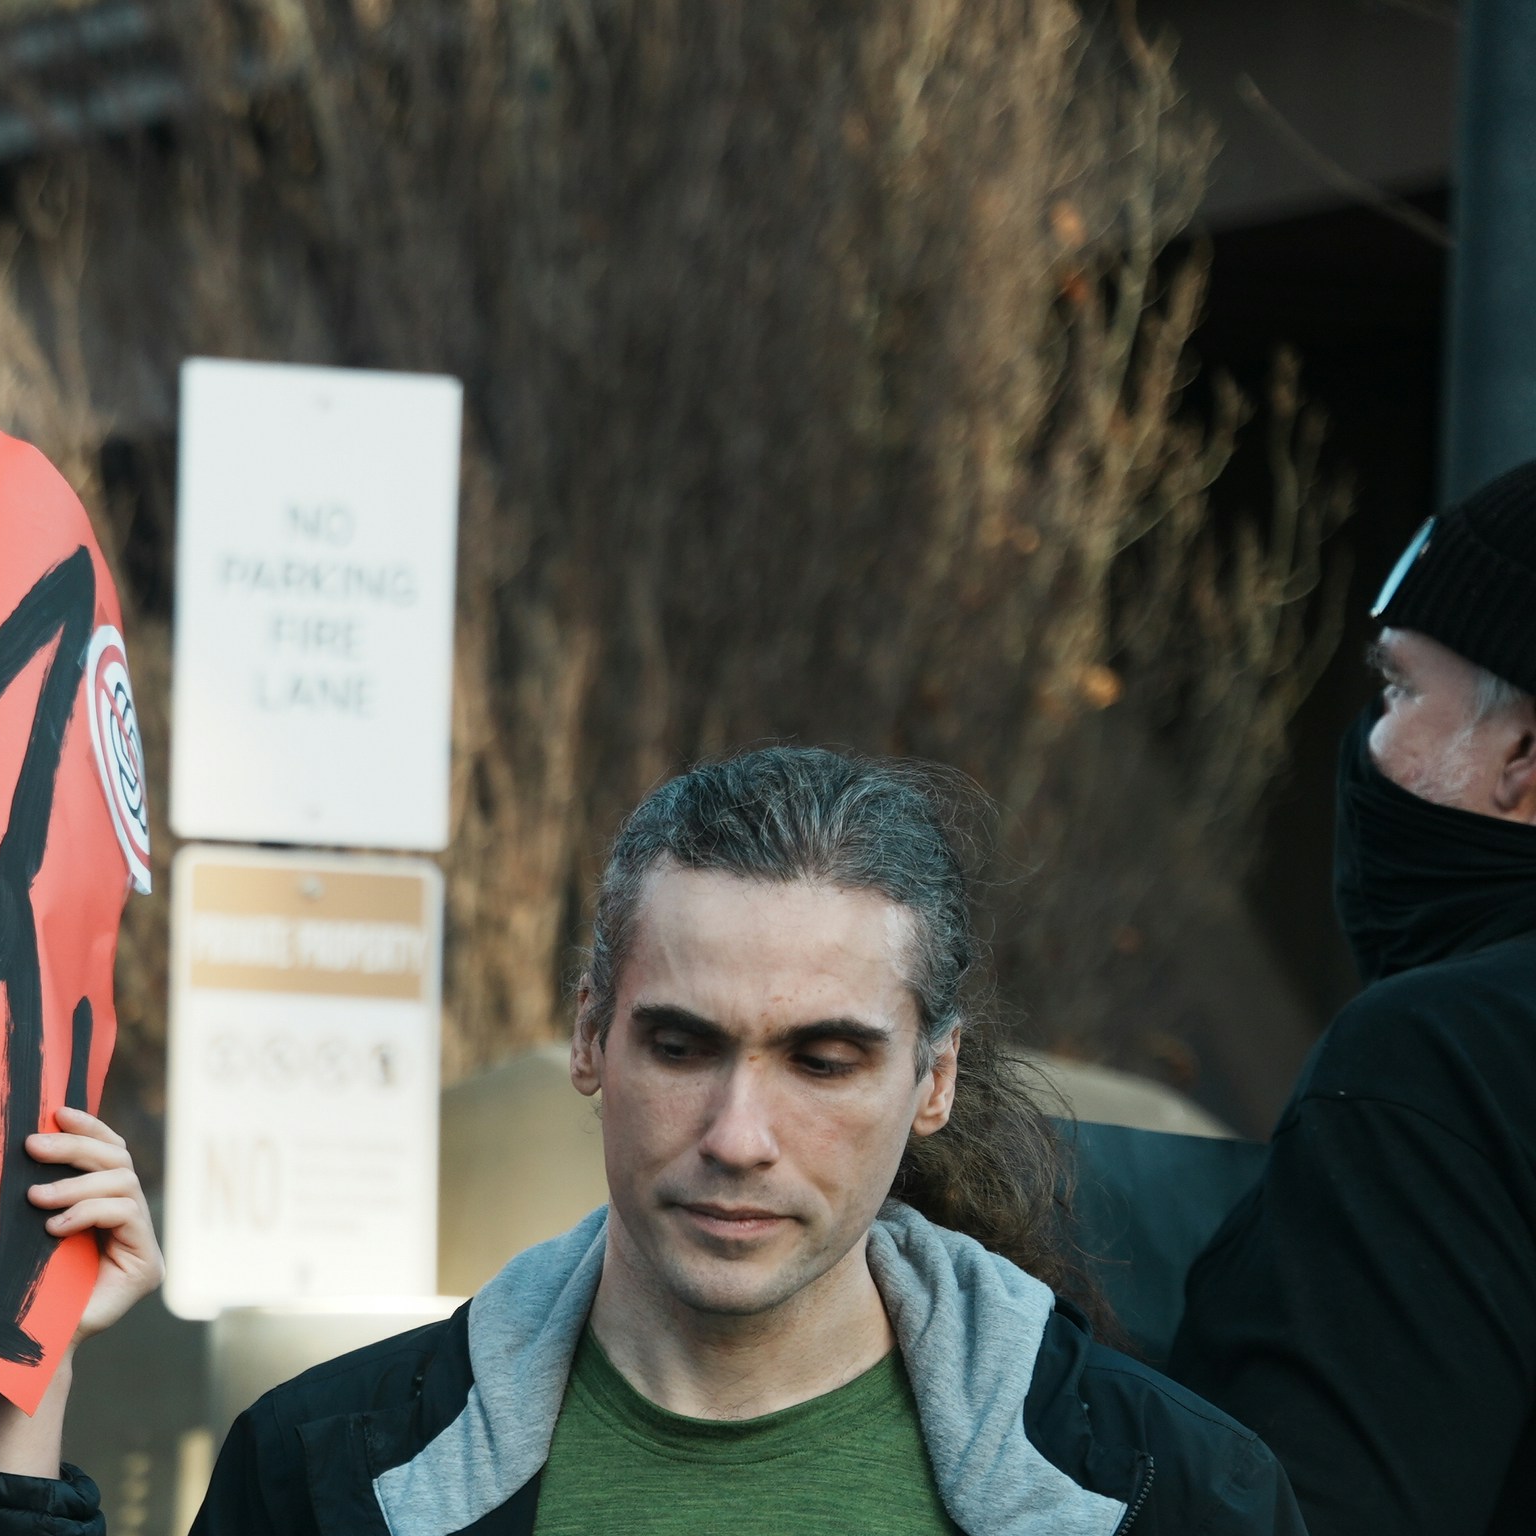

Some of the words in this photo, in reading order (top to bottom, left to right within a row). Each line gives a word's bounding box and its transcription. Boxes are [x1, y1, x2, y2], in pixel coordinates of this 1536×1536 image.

[283, 500, 355, 546] NO
[217, 554, 417, 606] PARKING
[269, 612, 364, 661] FIRE
[252, 669, 375, 717] LANE
[201, 1136, 282, 1232] NO
